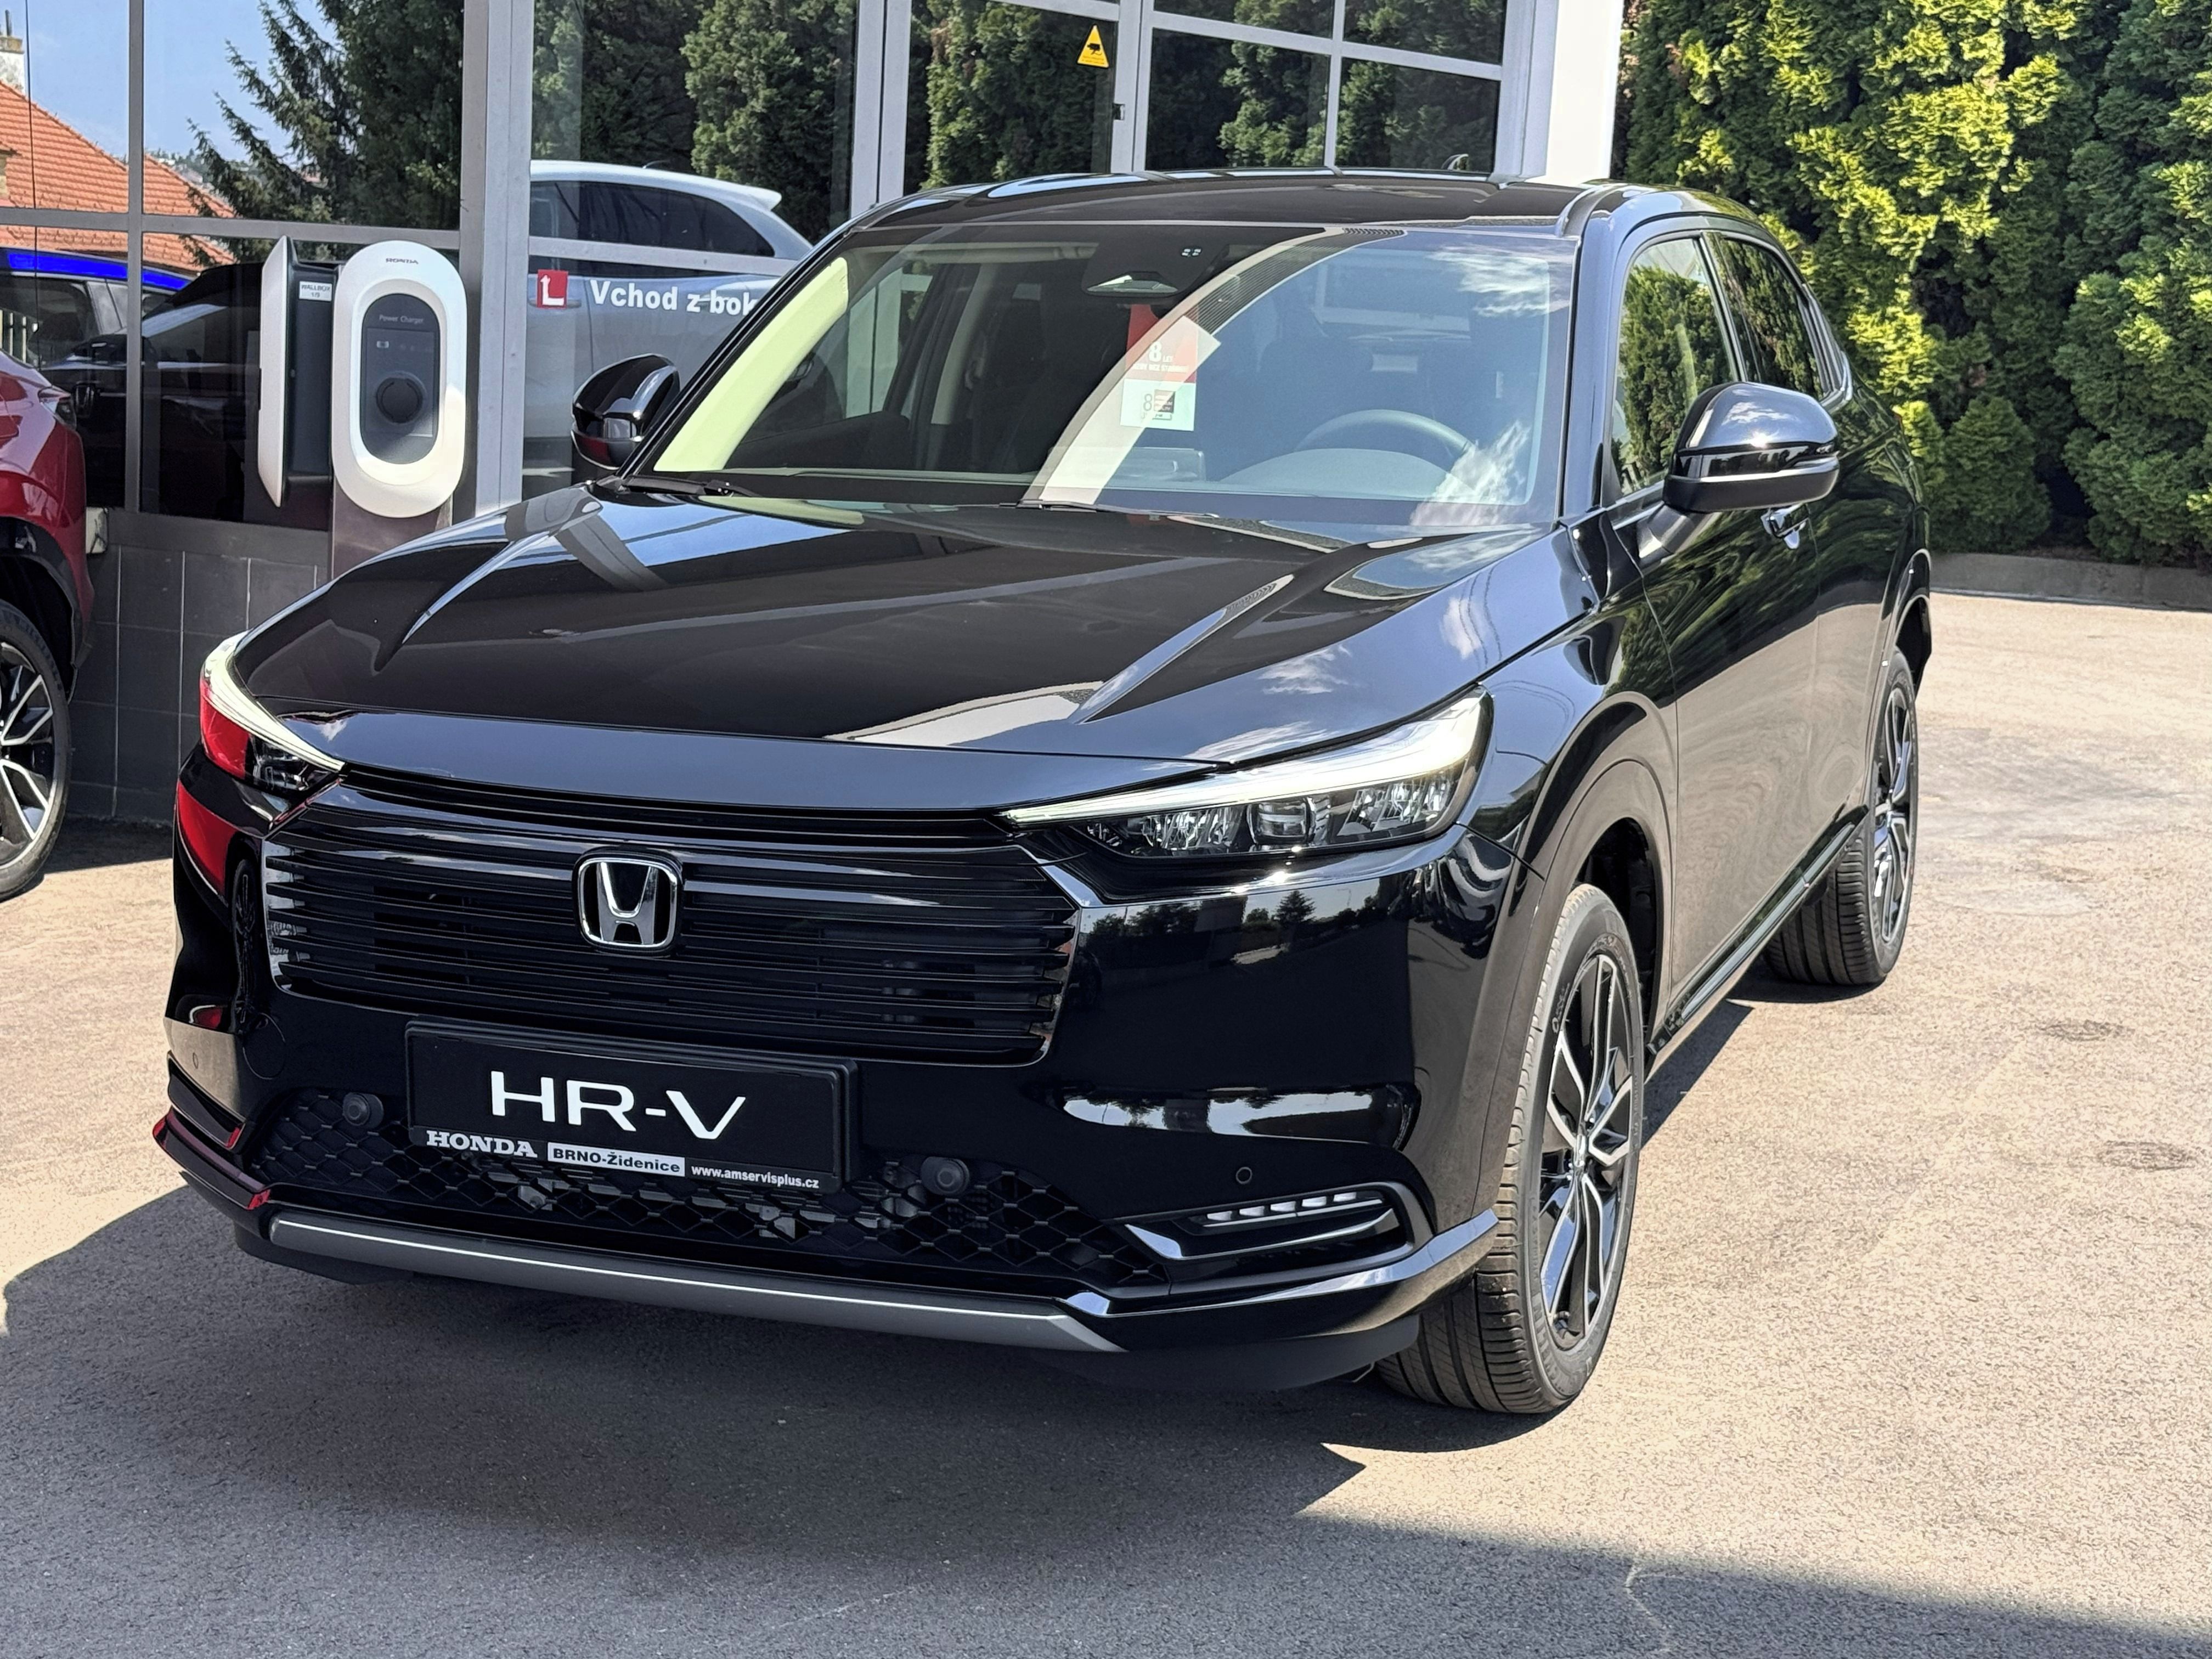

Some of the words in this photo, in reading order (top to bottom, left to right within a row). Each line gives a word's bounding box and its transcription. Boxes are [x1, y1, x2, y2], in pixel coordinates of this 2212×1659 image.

[301, 284, 331, 292] WALLBOX
[590, 279, 678, 311] Vchod
[686, 294, 701, 312] z
[379, 314, 399, 323] Power
[400, 315, 425, 325] Charger
[1149, 341, 1162, 362] 8
[491, 1070, 746, 1139] HR-V
[426, 1130, 538, 1158] HONDA
[553, 1148, 681, 1173] BRNO-Židenice
[691, 1165, 820, 1189] www.amservisplus.cz
